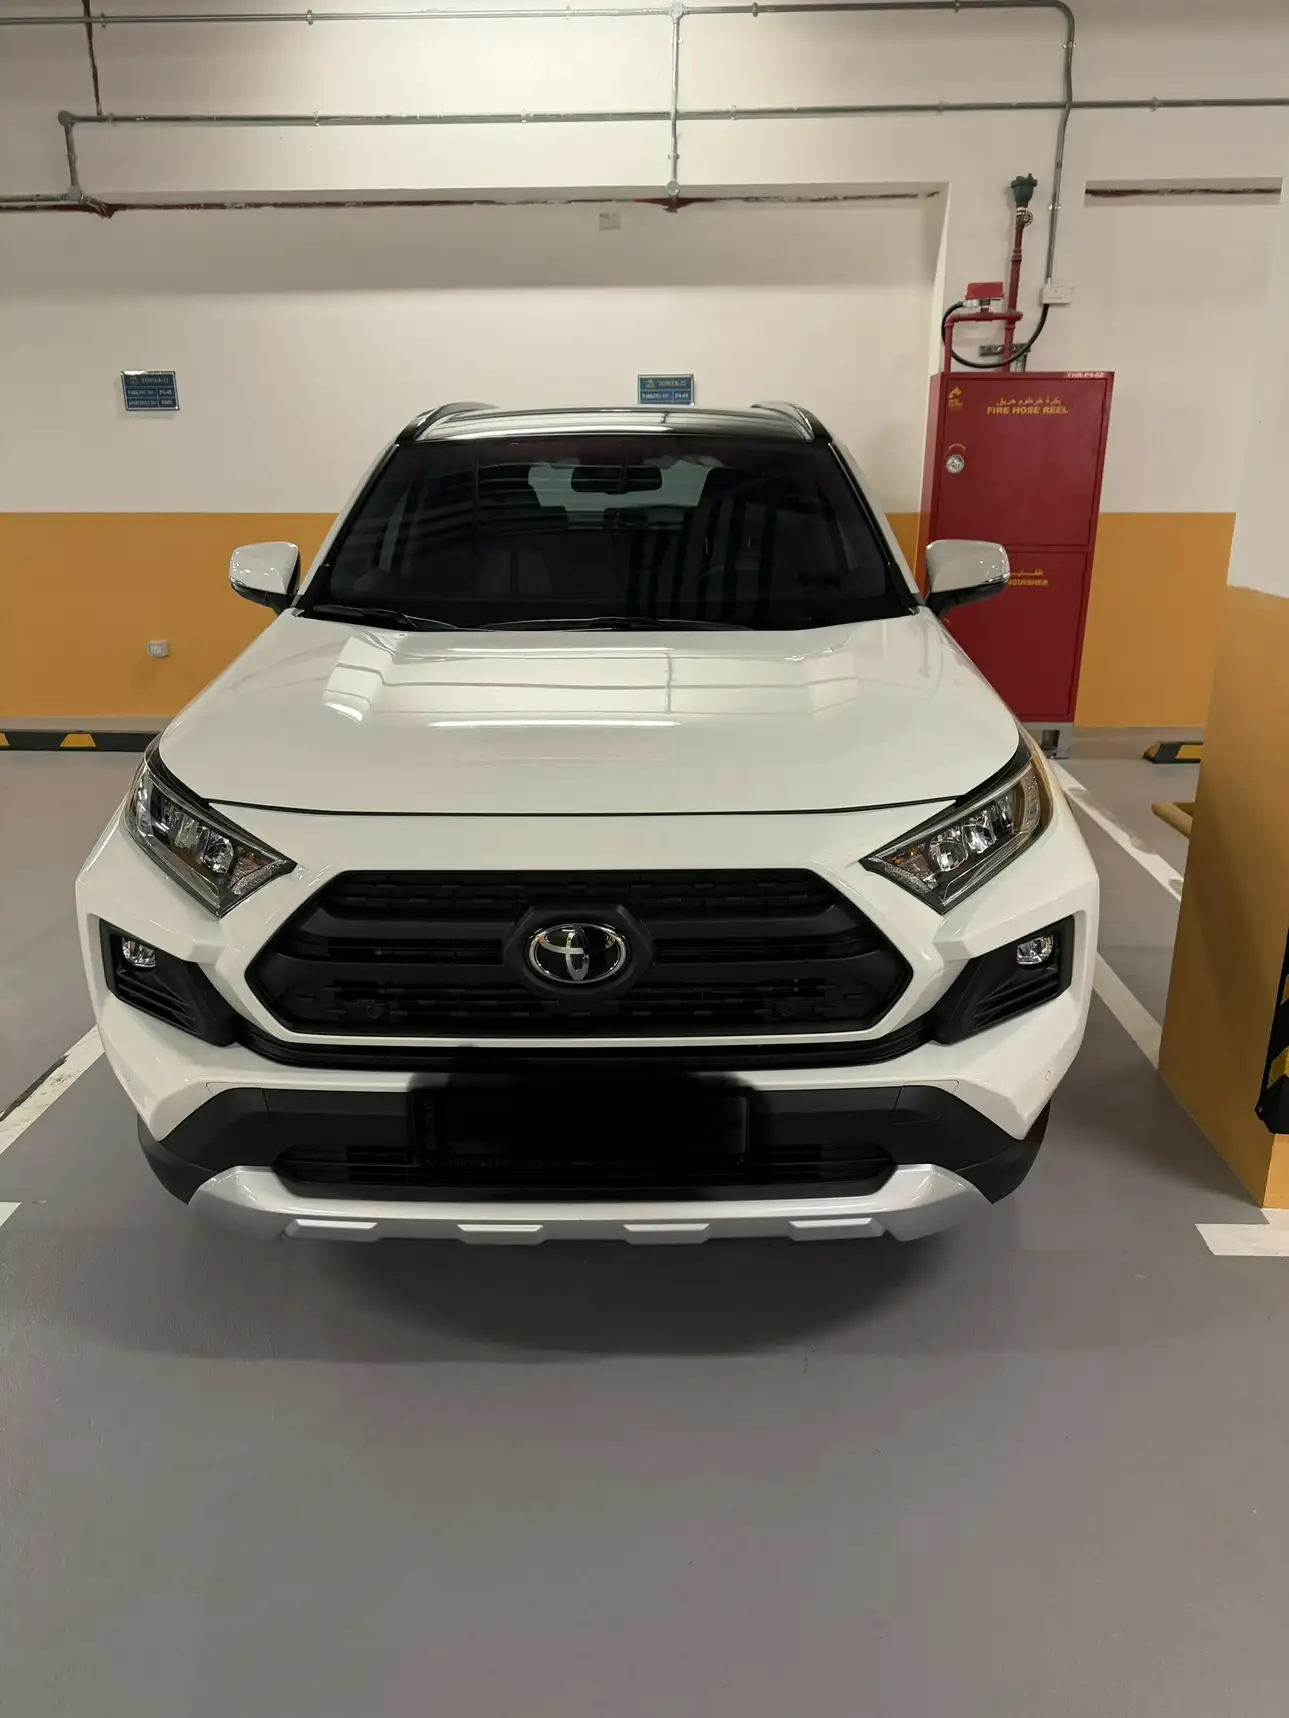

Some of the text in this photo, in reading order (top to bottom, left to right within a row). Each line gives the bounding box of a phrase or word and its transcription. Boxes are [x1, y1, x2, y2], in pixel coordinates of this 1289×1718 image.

[987, 406, 1069, 415] FIRE HOSE REEL
